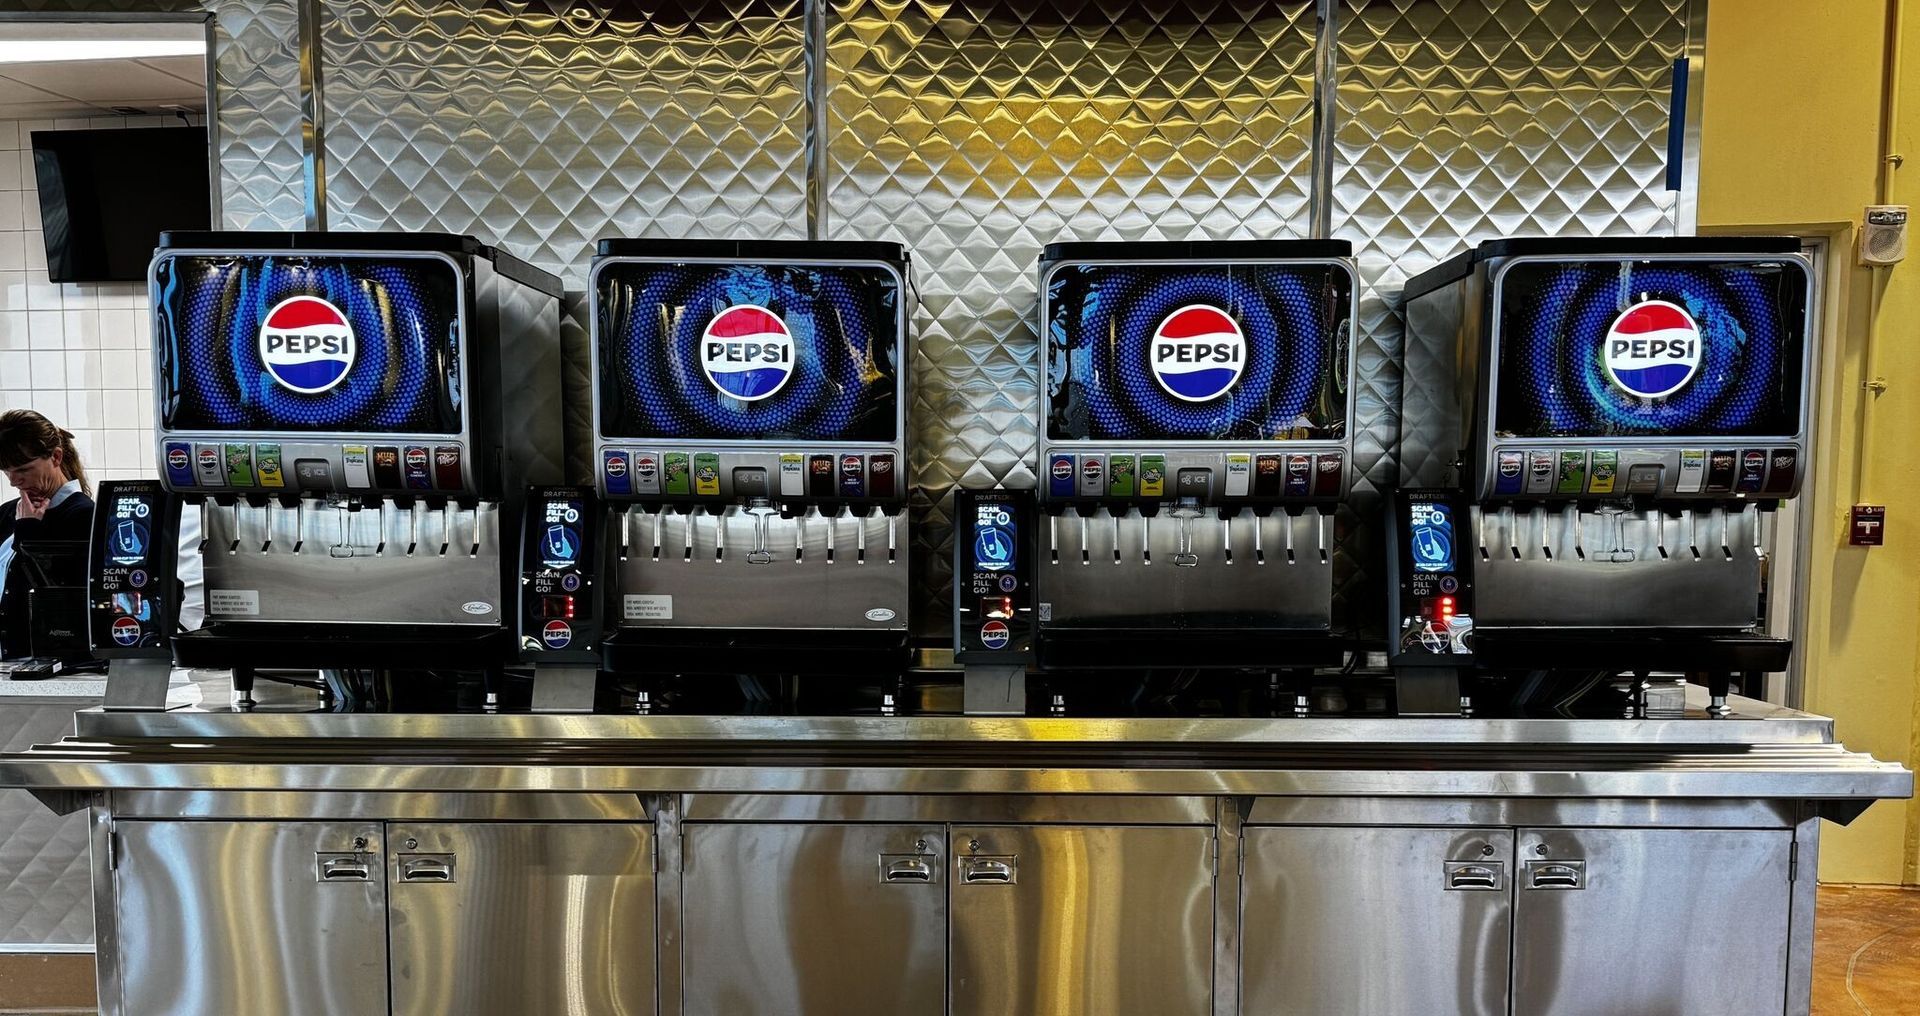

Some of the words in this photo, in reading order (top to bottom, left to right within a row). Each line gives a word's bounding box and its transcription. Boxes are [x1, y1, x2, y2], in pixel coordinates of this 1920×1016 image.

[267, 335, 348, 354] PEPSI
[707, 343, 789, 363] PEPSI
[1158, 343, 1239, 363] PEPSI
[1612, 339, 1694, 359] PEPSI
[1194, 475, 1206, 483] ICE
